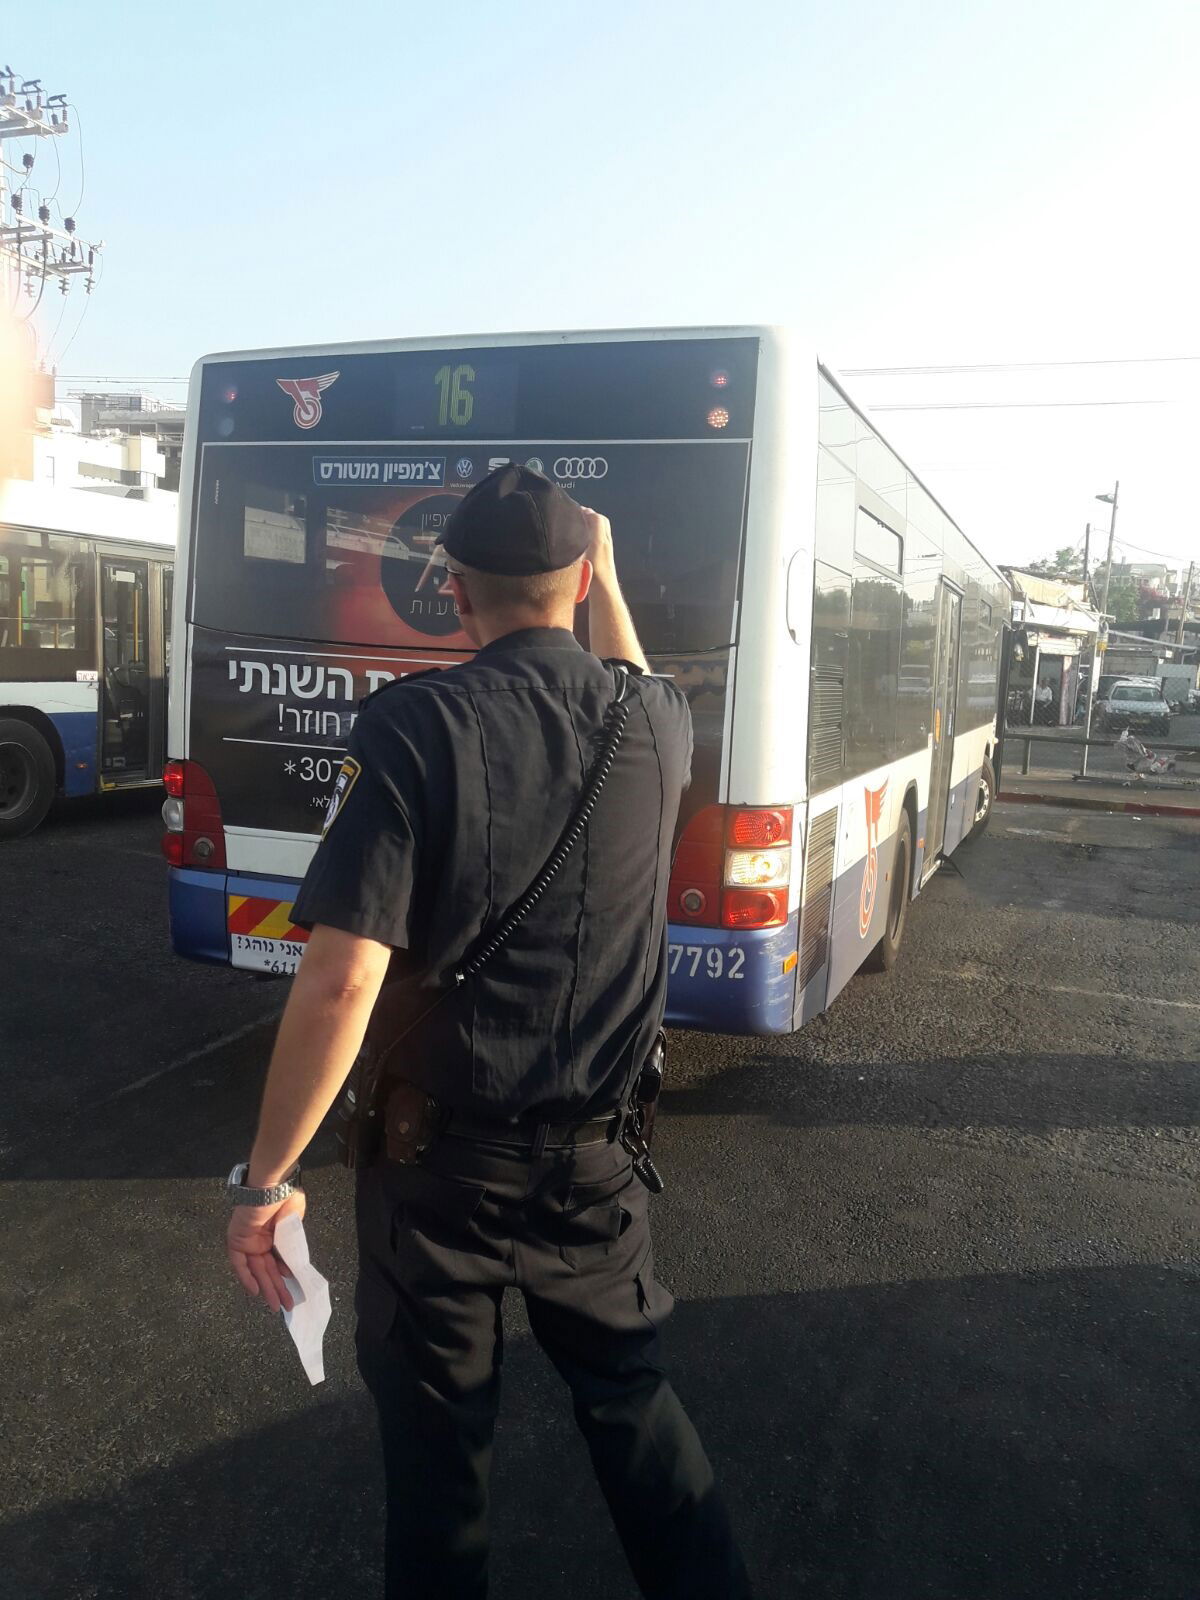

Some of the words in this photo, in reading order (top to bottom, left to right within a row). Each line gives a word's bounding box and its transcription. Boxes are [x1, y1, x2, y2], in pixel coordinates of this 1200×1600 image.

[434, 365, 476, 426] 16
[320, 462, 380, 480] מוטורס
[228, 660, 354, 701] השנתי
[278, 703, 341, 737] חוזר!
[237, 935, 275, 953] נוהג?
[279, 942, 303, 957] אני
